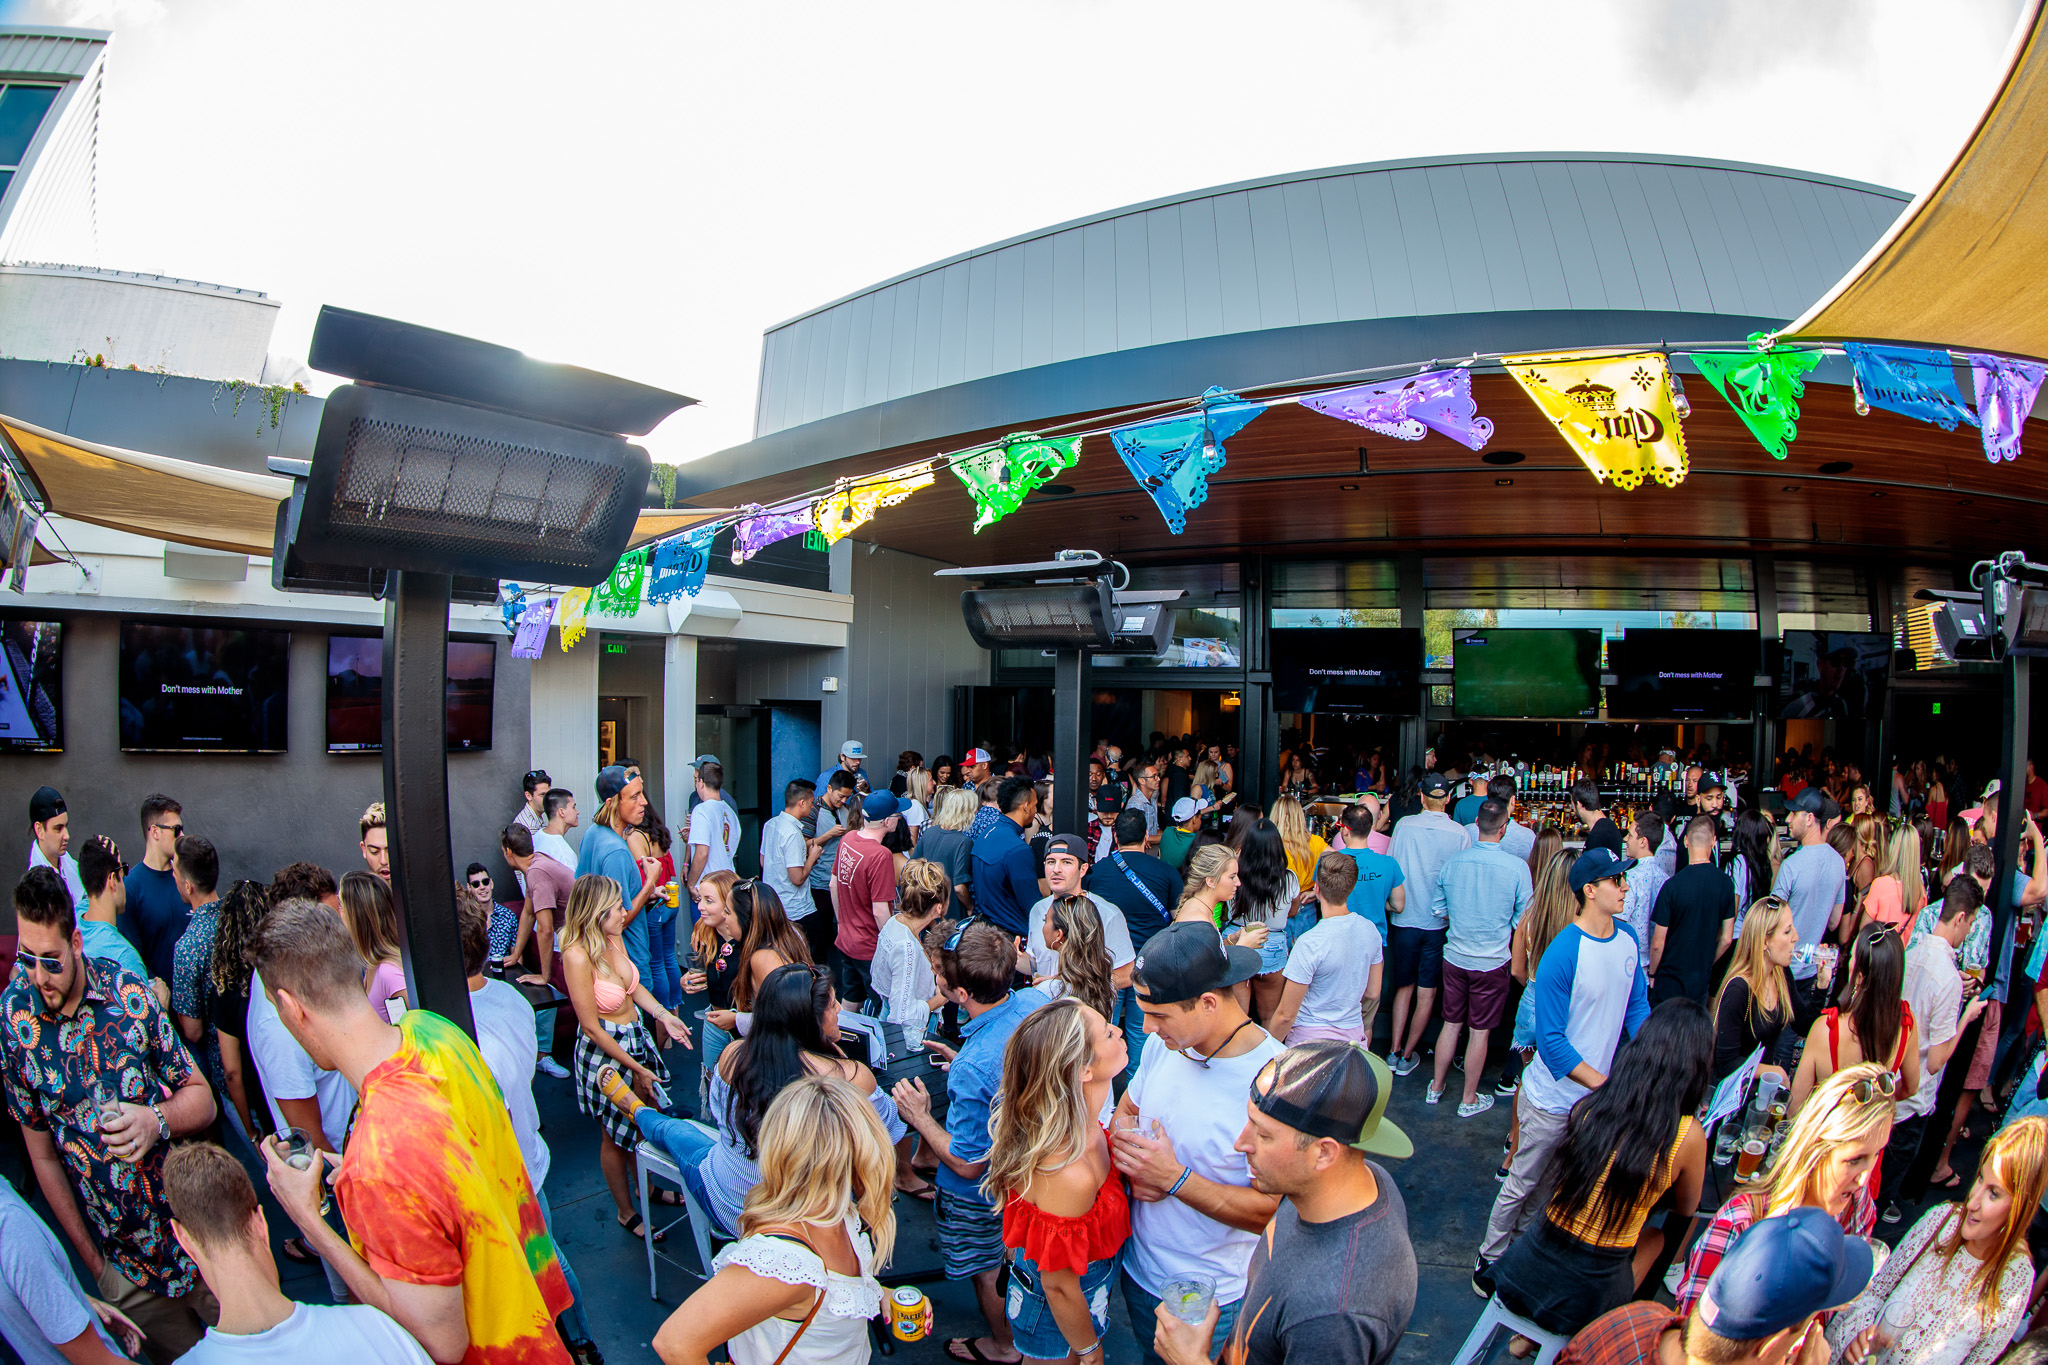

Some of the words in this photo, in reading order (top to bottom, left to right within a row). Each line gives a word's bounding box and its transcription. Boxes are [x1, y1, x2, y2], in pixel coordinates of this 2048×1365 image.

[161, 684, 181, 694] Don't
[181, 686, 200, 694] mess
[201, 686, 217, 694] with
[217, 686, 243, 695] Mother
